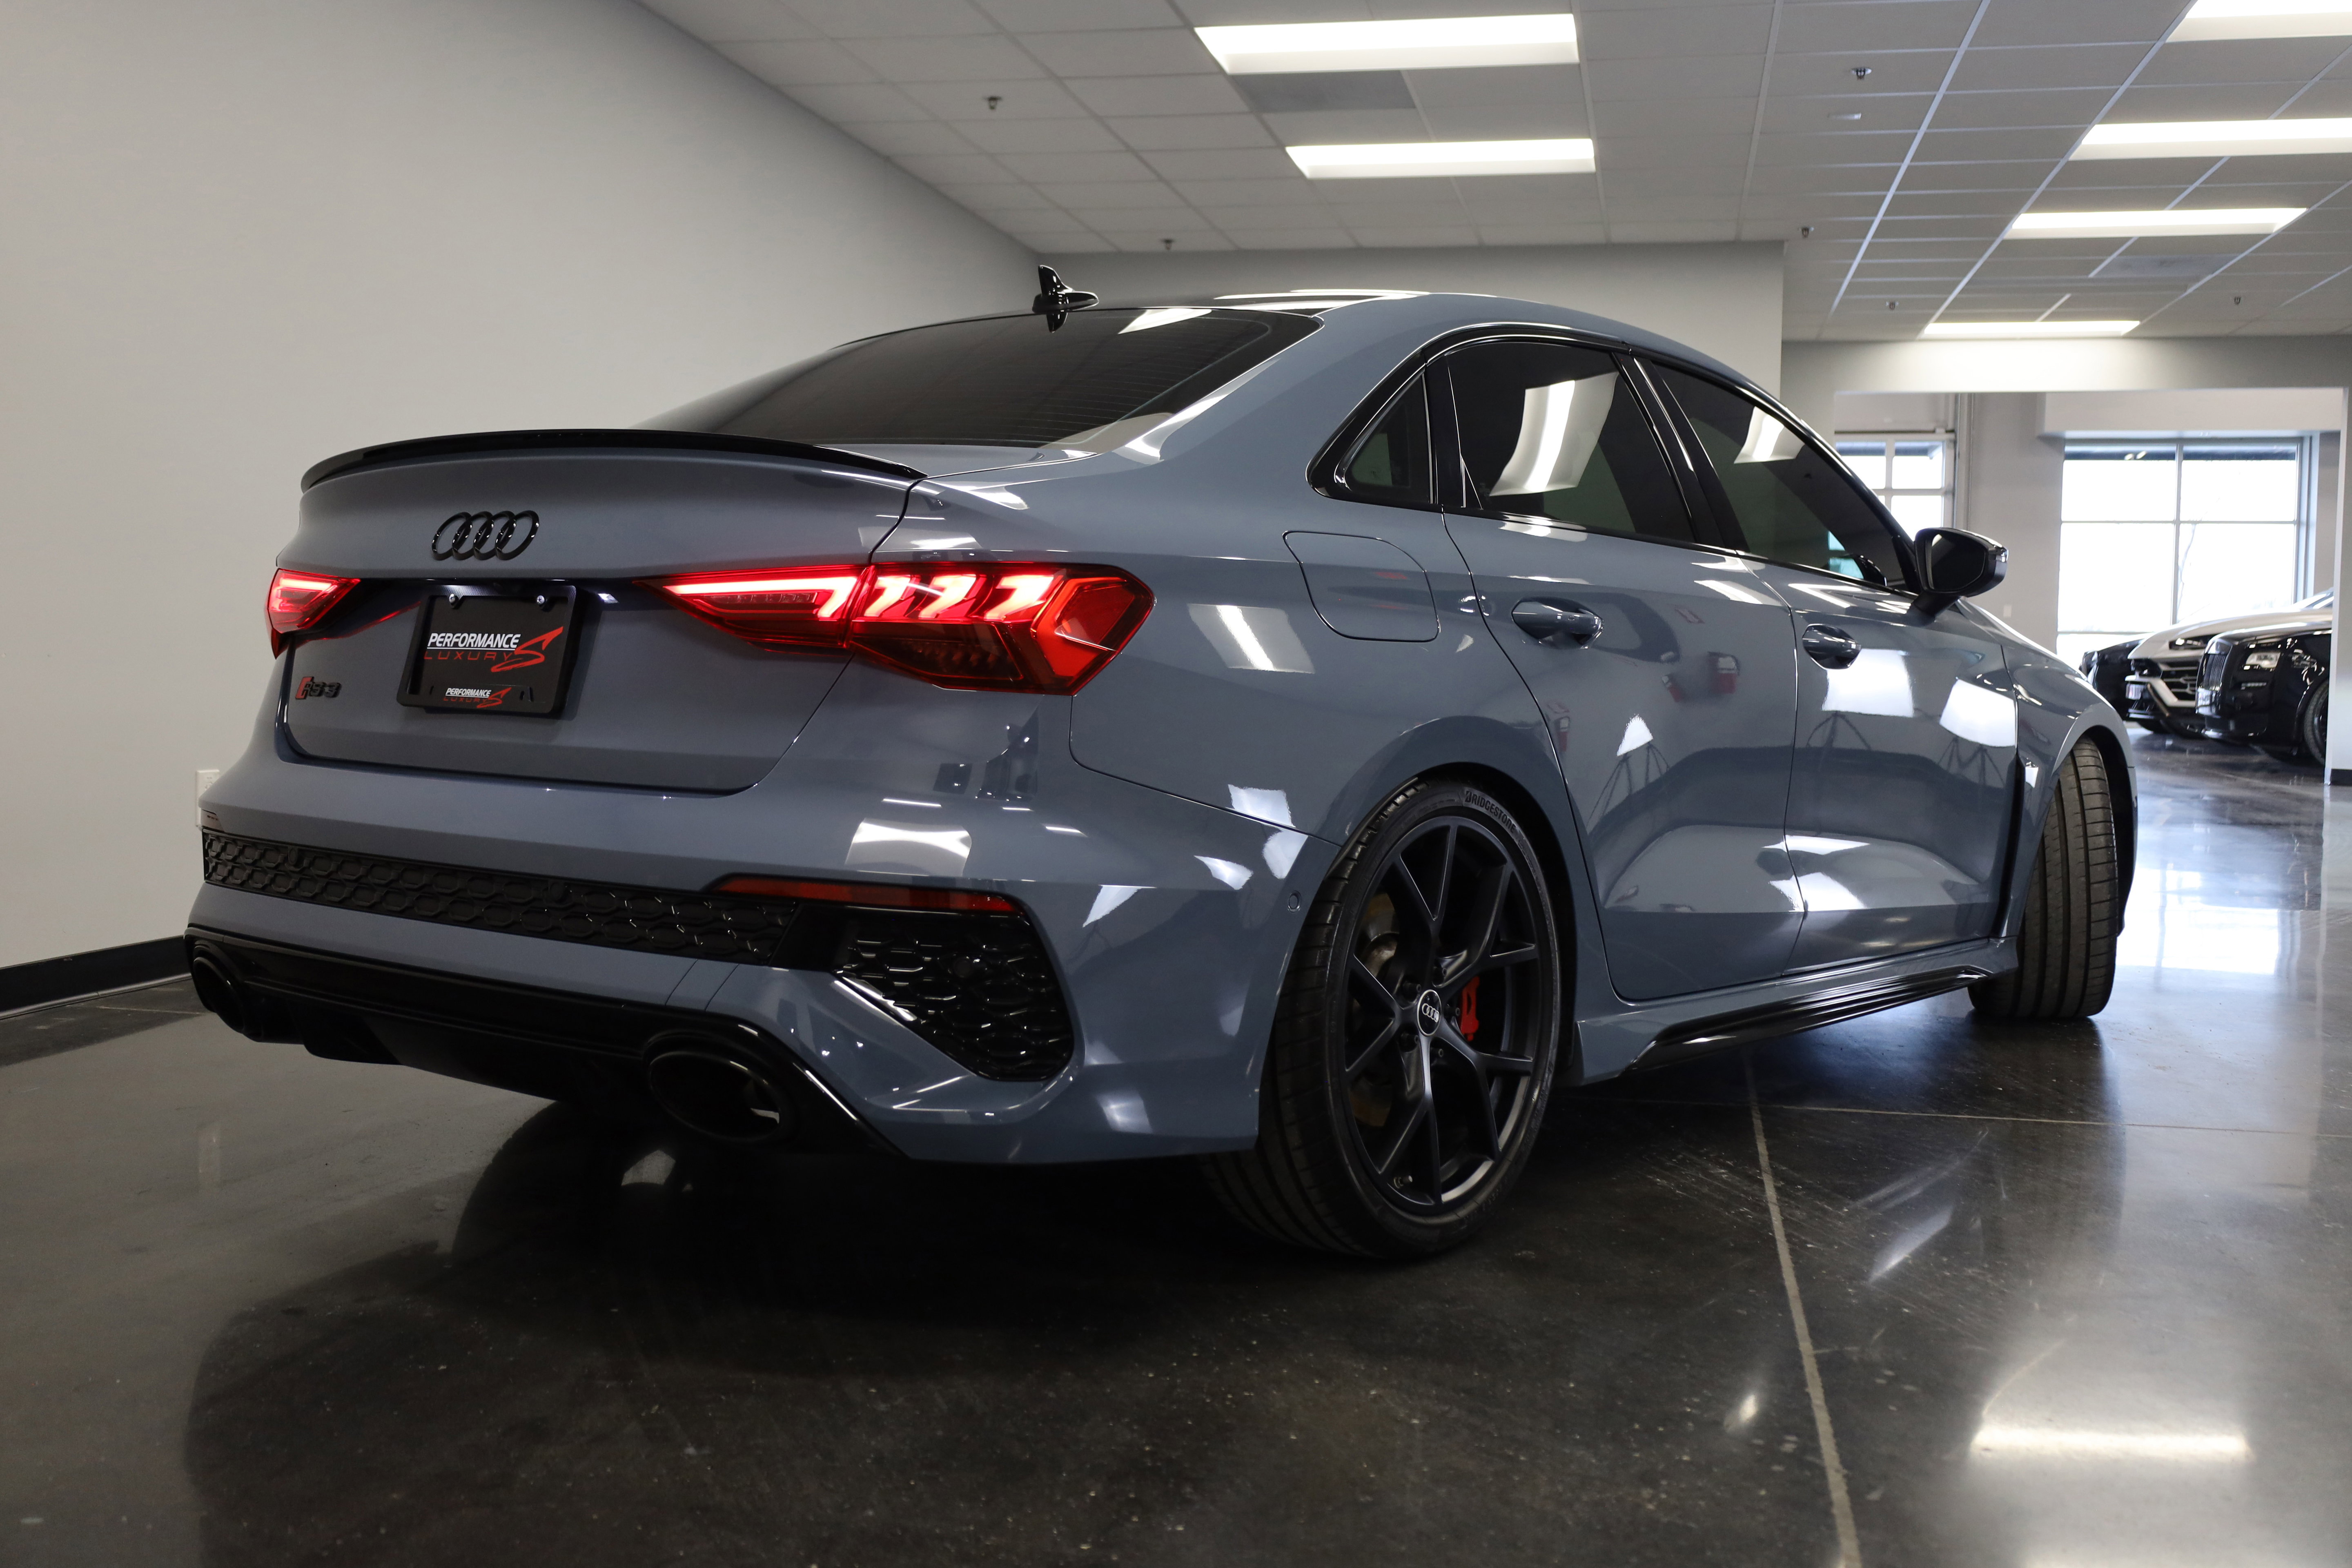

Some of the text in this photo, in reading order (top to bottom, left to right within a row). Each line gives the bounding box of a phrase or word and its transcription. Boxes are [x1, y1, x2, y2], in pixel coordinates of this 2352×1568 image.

[427, 633, 521, 648] PERFORMANCE
[423, 651, 513, 661] LUXURY
[445, 688, 492, 697] PERFORMANCE
[1464, 790, 1517, 833] BRIDGESTONE
